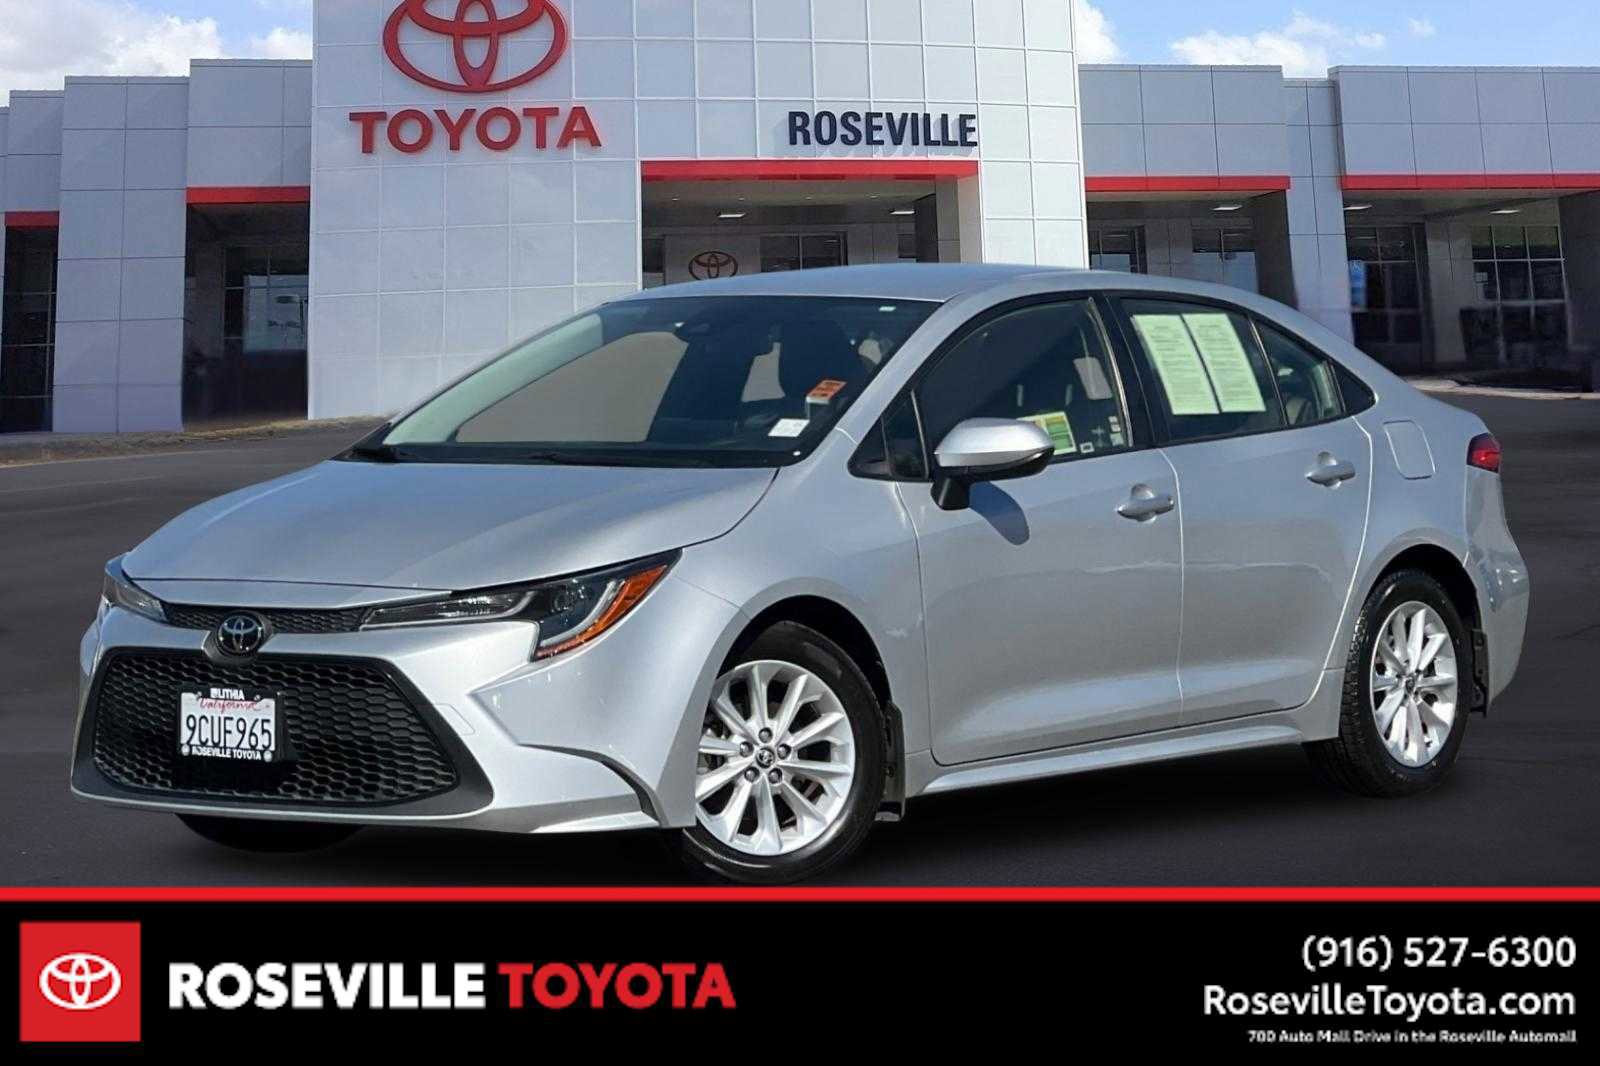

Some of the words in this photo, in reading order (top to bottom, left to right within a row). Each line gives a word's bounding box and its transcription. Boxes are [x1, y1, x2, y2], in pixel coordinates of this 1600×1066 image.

[349, 106, 602, 154] TOYOTA
[788, 110, 978, 147] ROSEVILLE
[186, 714, 273, 751] 9CUF965
[191, 746, 231, 758] ROSEVILLE
[232, 749, 262, 760] TOYOTA
